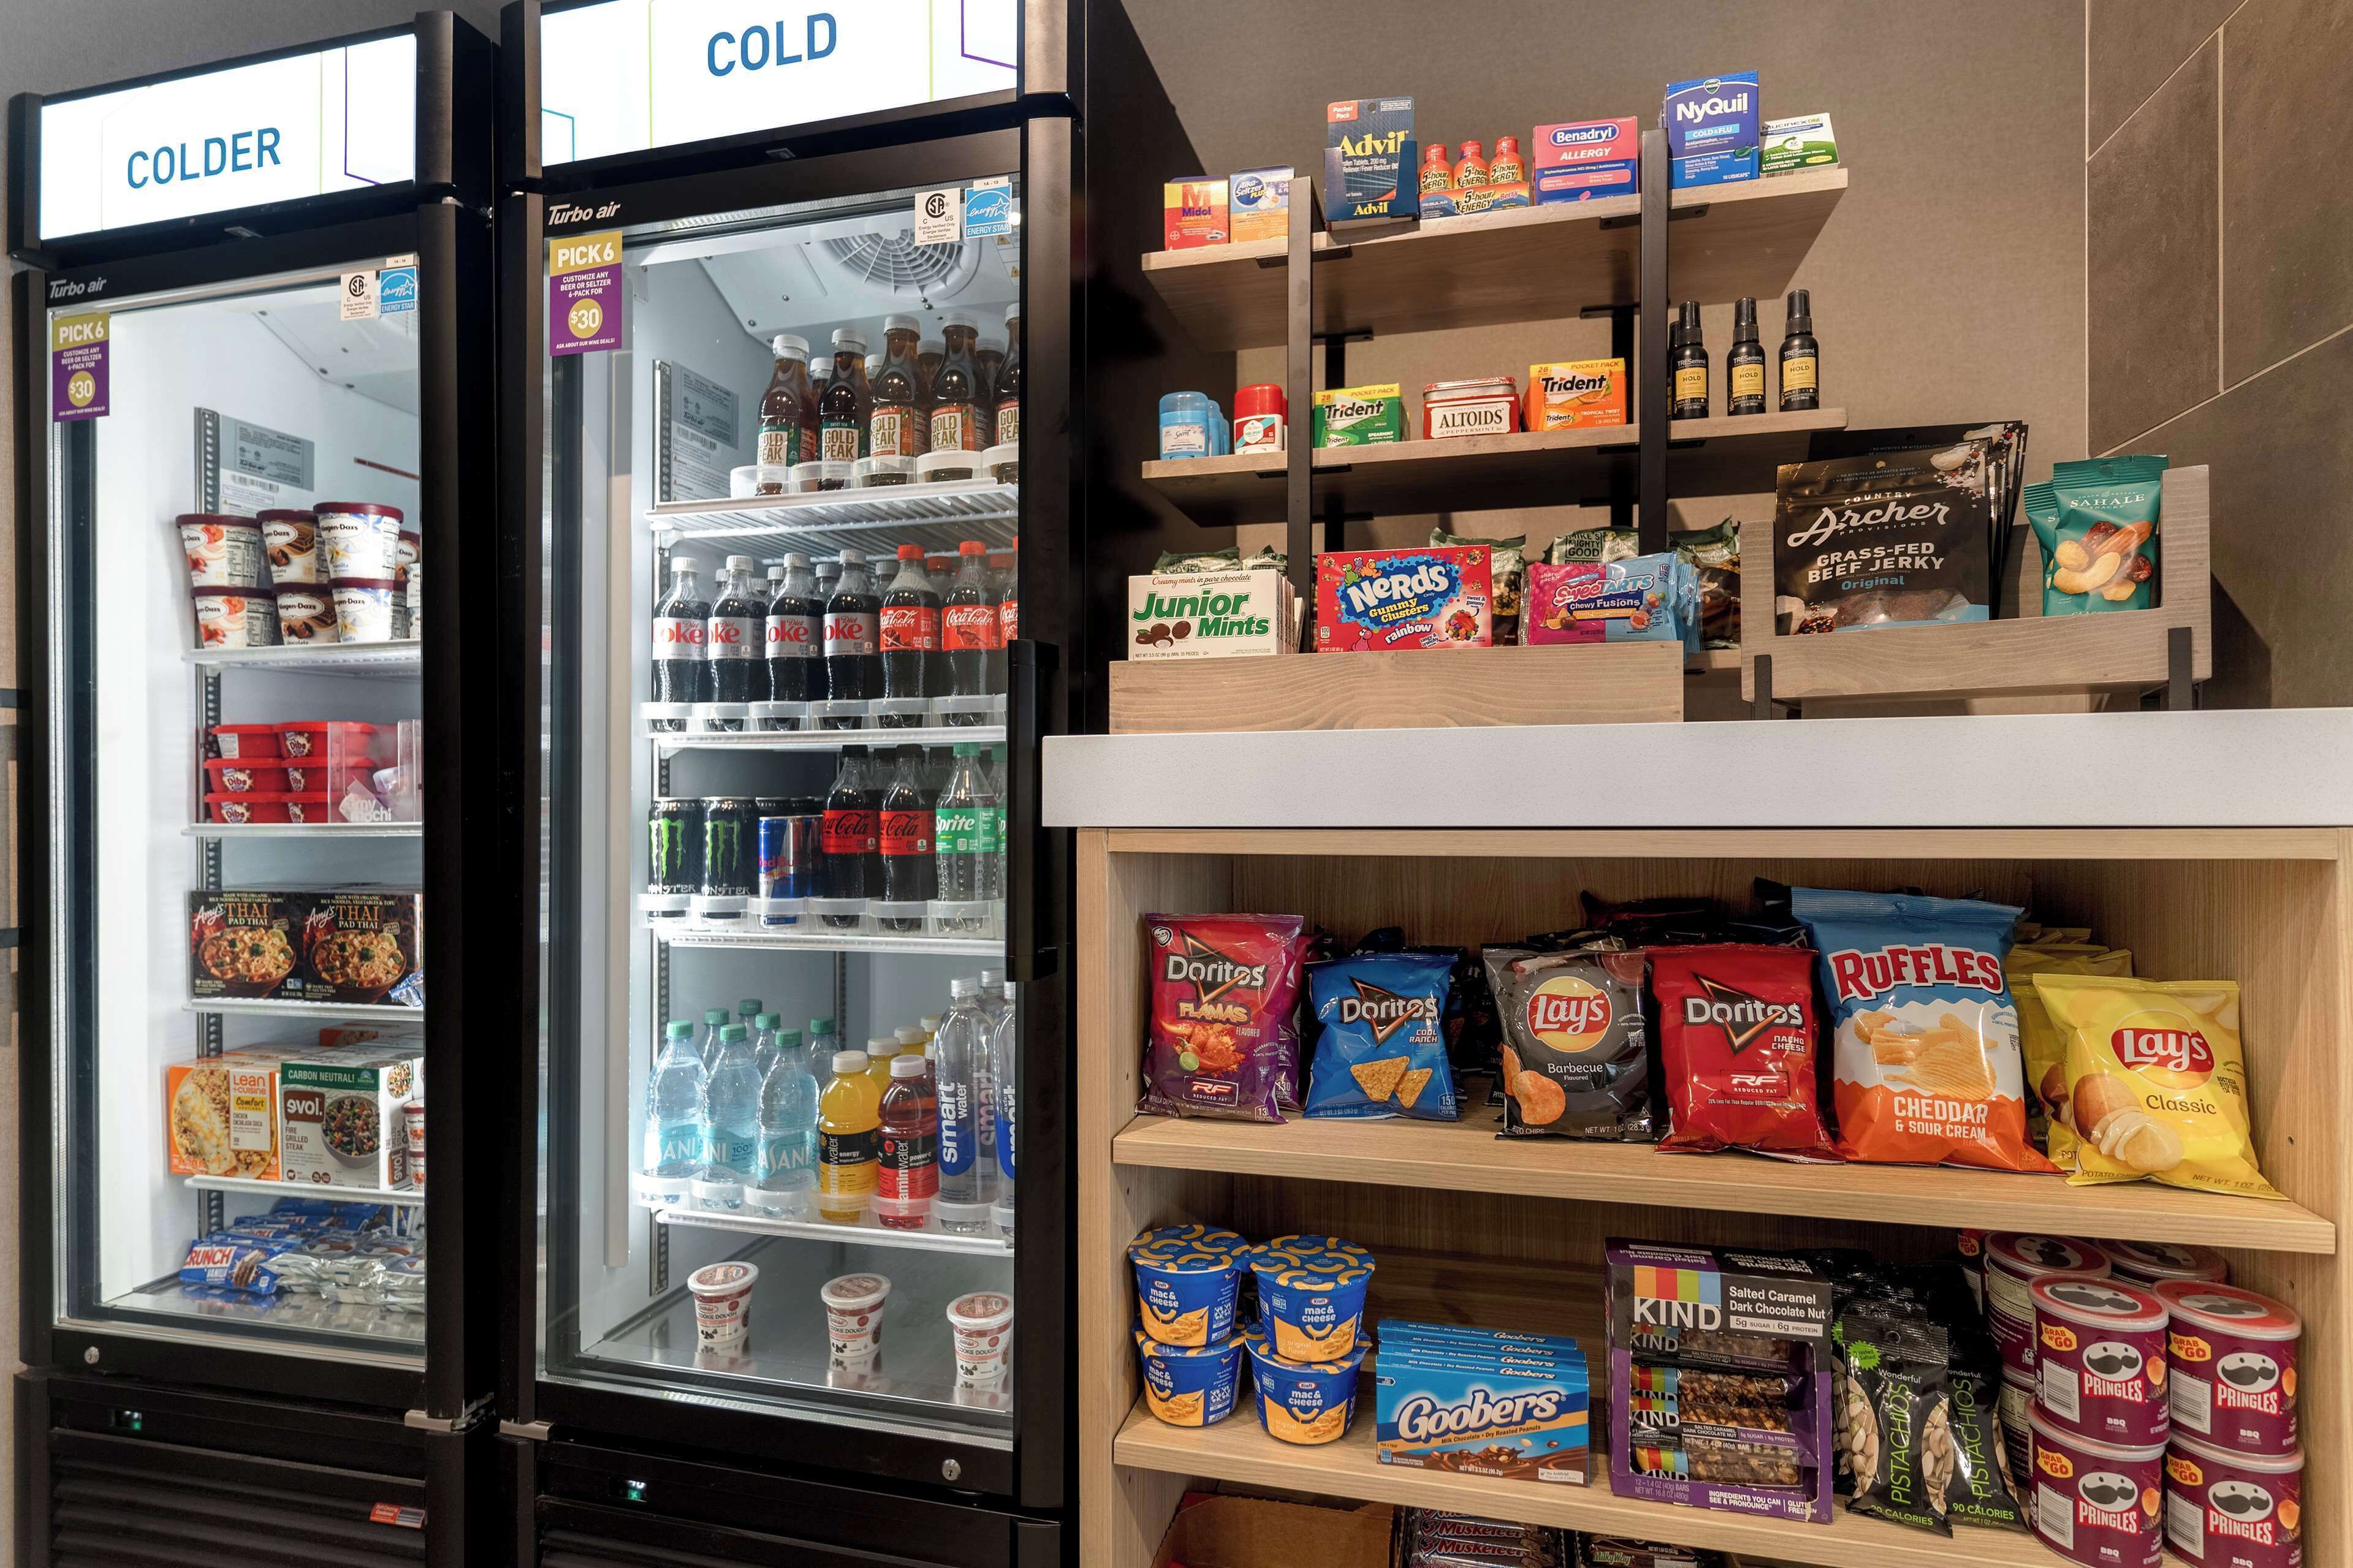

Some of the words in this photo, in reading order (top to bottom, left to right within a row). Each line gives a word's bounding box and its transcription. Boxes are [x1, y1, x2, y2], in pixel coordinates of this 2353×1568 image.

[707, 12, 836, 77] COLD
[1677, 93, 1748, 123] NyQuil
[1556, 127, 1613, 145] Benadryl
[1693, 129, 1714, 138] COLD
[1340, 131, 1405, 157] Advil
[127, 127, 281, 189] COLDER
[1560, 148, 1612, 161] ALLERGY
[1236, 184, 1263, 197] Seltzer
[1250, 190, 1266, 199] PLUS
[1465, 191, 1493, 203] 5-hour
[1500, 191, 1518, 200] Berry
[549, 203, 593, 225] Turbo
[596, 201, 621, 219] air
[1182, 206, 1211, 216] Midol
[1354, 202, 1388, 216] Advil
[1461, 199, 1491, 213] ENERGY
[967, 227, 991, 235] ENERGY
[558, 244, 601, 268] PICK
[603, 242, 614, 262] 6
[560, 283, 576, 292] BEER
[586, 279, 611, 287] SELTZER
[563, 273, 595, 283] CUSTOMIZE
[50, 279, 85, 298] Turbo
[88, 277, 106, 293] air
[569, 289, 590, 298] 6-PACK
[571, 308, 599, 329] $30
[59, 322, 94, 343] PICK
[95, 321, 104, 338] 6
[70, 379, 93, 398] $30
[1541, 374, 1606, 392] Trident
[1325, 401, 1383, 419] Trident
[1440, 409, 1502, 428] ALTOIDS
[825, 430, 854, 444] GOLD
[824, 444, 854, 458] PEAK
[1844, 491, 1912, 506] COUNTRY
[2070, 494, 2145, 507] SAHALE
[1787, 501, 1950, 547] Archer
[1840, 521, 1926, 536] PROVISIONS
[1568, 547, 1599, 557] GOOD
[1817, 542, 1934, 567] GRASS-FED
[1809, 562, 1862, 583] BEEF
[1869, 556, 1945, 572] JERKY
[1152, 577, 1177, 588] Creamy
[1204, 576, 1219, 585] pure
[1220, 574, 1252, 582] chocolate
[1842, 575, 1904, 590] Original
[1133, 589, 1250, 621] Junior
[1369, 597, 1418, 618] Gummy
[1597, 599, 1640, 608] Fusions
[1381, 604, 1429, 623] Clusters
[1196, 615, 1271, 638] Mints
[1385, 623, 1433, 643] rainbow
[289, 741, 306, 751] Dibs
[936, 814, 975, 834] Sprite
[195, 903, 225, 929] Amy's
[225, 903, 268, 918] THAI
[1168, 955, 1264, 988] Doritos
[1833, 947, 2002, 998] RUFFLES
[1179, 1002, 1248, 1023] FLAMAS
[1344, 998, 1438, 1022] Doritos
[1535, 994, 1605, 1035] Lay's
[1687, 998, 1803, 1025] Doritos
[1236, 1027, 1260, 1037] FLAVORED
[1774, 1036, 1804, 1045] NACHO
[1772, 1043, 1805, 1053] CHEESE
[2123, 1029, 2207, 1072] Lay's
[288, 1070, 317, 1081] CARBON
[319, 1072, 354, 1083] NEUTRAL!
[1548, 1062, 1603, 1074] Barbecue
[233, 1075, 265, 1088] Lean
[236, 1097, 265, 1107] Comfort
[1441, 1096, 1454, 1105] 150
[2146, 1095, 2217, 1115] Classic
[1894, 1096, 1988, 1124] CHEDDAR
[938, 1082, 957, 1164] smart
[957, 1083, 967, 1119] water
[1895, 1121, 1904, 1132] &
[1909, 1122, 1942, 1135] SOUR
[1947, 1125, 1986, 1140] CREAM
[286, 1135, 308, 1144] GRILLED
[286, 1142, 303, 1151] STEAK
[184, 1248, 236, 1268] CRUNCH
[1730, 1287, 1765, 1300] Salted
[1768, 1290, 1815, 1304] Caramel
[1635, 1297, 1721, 1330] KIND
[1730, 1301, 1753, 1313] Dark
[1755, 1303, 1806, 1318] Chocolate
[1808, 1308, 1825, 1319] Nut
[1736, 1318, 1747, 1327] 5g
[1777, 1322, 1789, 1331] 6g
[2044, 1327, 2066, 1337] GRAB
[1500, 1368, 1555, 1379] Goobers
[1879, 1368, 1922, 1384] Wonderful
[2085, 1373, 2142, 1403] PRINGLES
[2218, 1384, 2277, 1414] PRINGLES
[1399, 1389, 1560, 1441] Goobers
[2107, 1417, 2126, 1427] BBQ
[1453, 1434, 1480, 1443] Chocolate
[1496, 1428, 1518, 1437] Roasted
[1519, 1425, 1540, 1433] Peanuts
[1891, 1384, 1911, 1504] PISTACHIOS
[1709, 1490, 1751, 1502] INGREDIENTS
[1752, 1495, 1765, 1504] YOU
[1953, 1503, 1965, 1512] 90
[1967, 1504, 2014, 1520] CALORIES
[2080, 1501, 2137, 1533] PRINGLES
